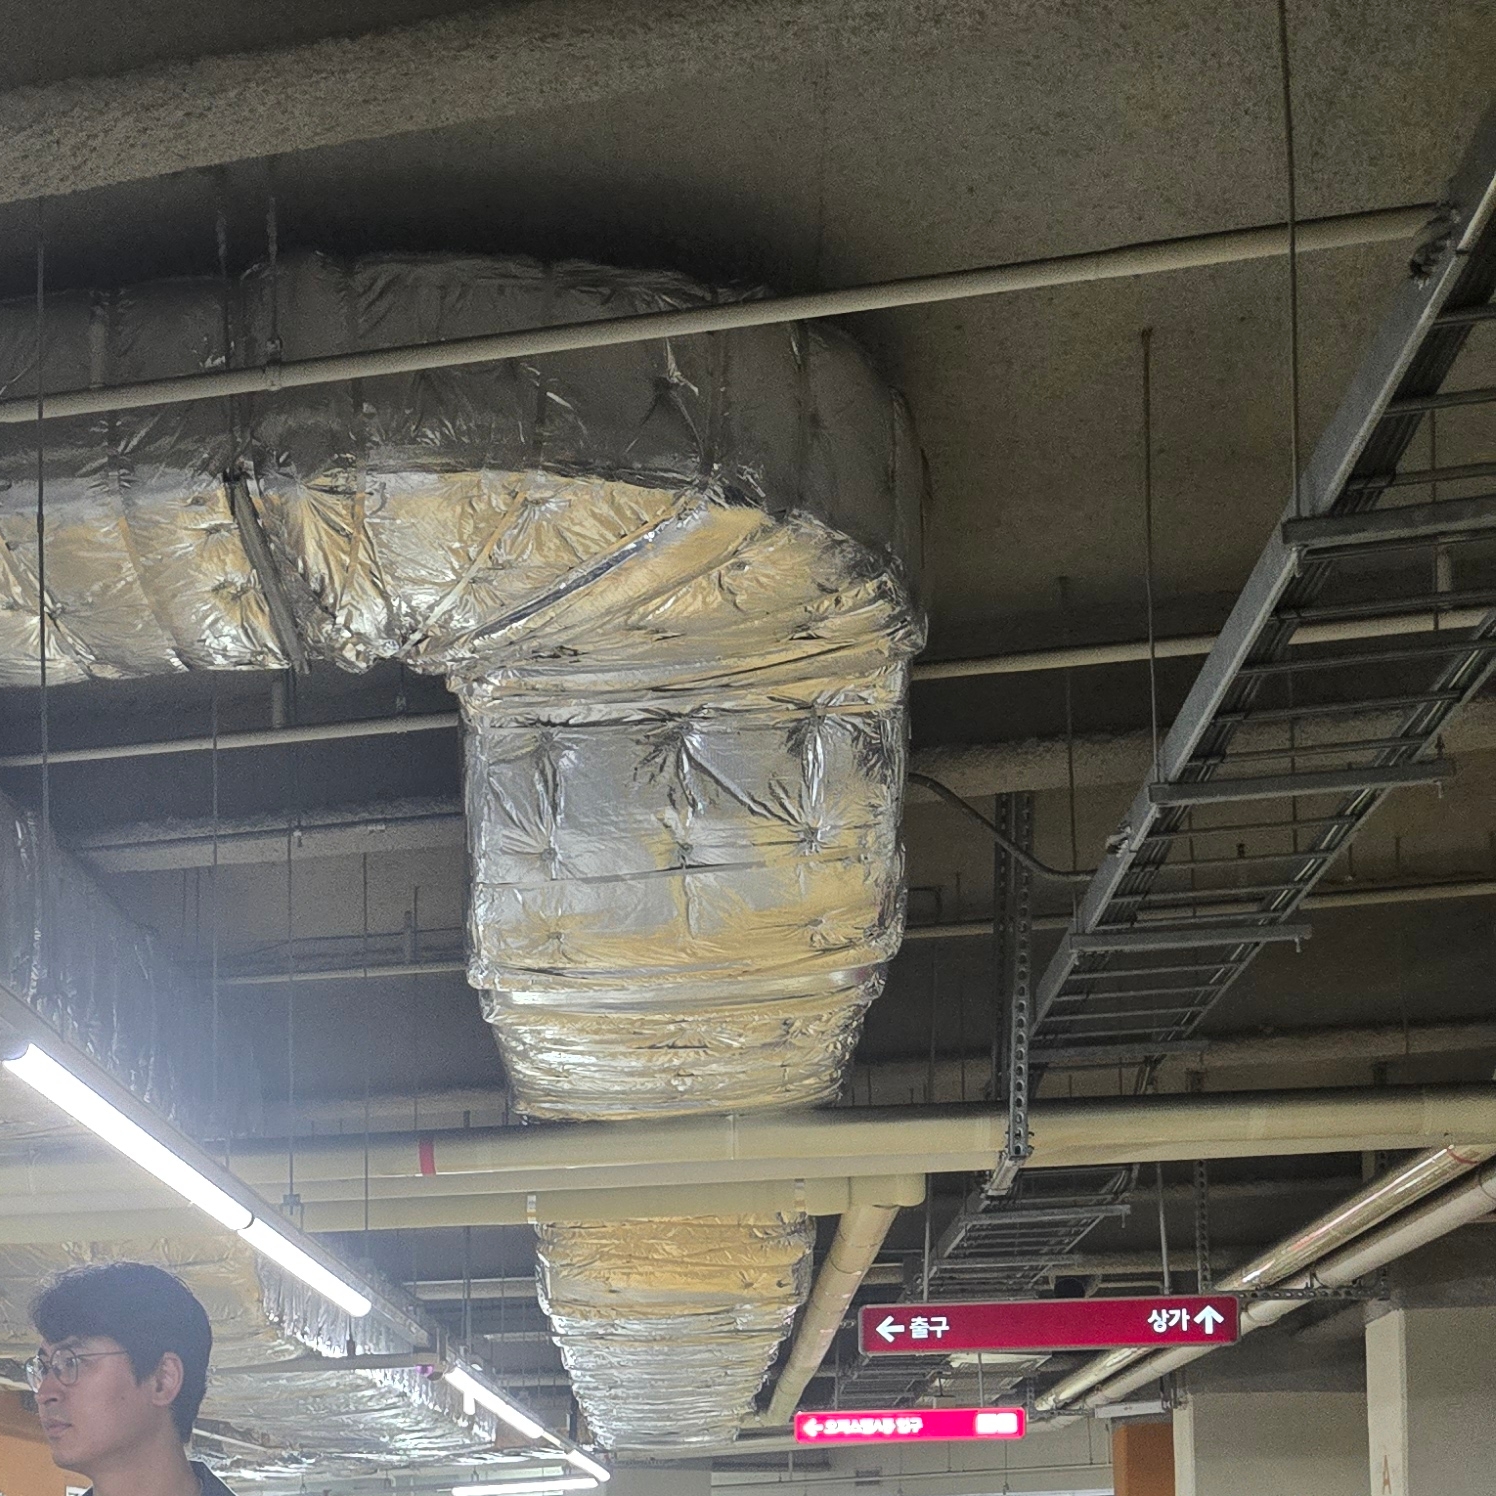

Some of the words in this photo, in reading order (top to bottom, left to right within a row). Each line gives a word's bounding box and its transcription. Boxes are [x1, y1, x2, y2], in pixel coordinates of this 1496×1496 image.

[909, 1316, 950, 1339] 출구
[1147, 1307, 1191, 1333] 상가
[1382, 1454, 1392, 1495] A
